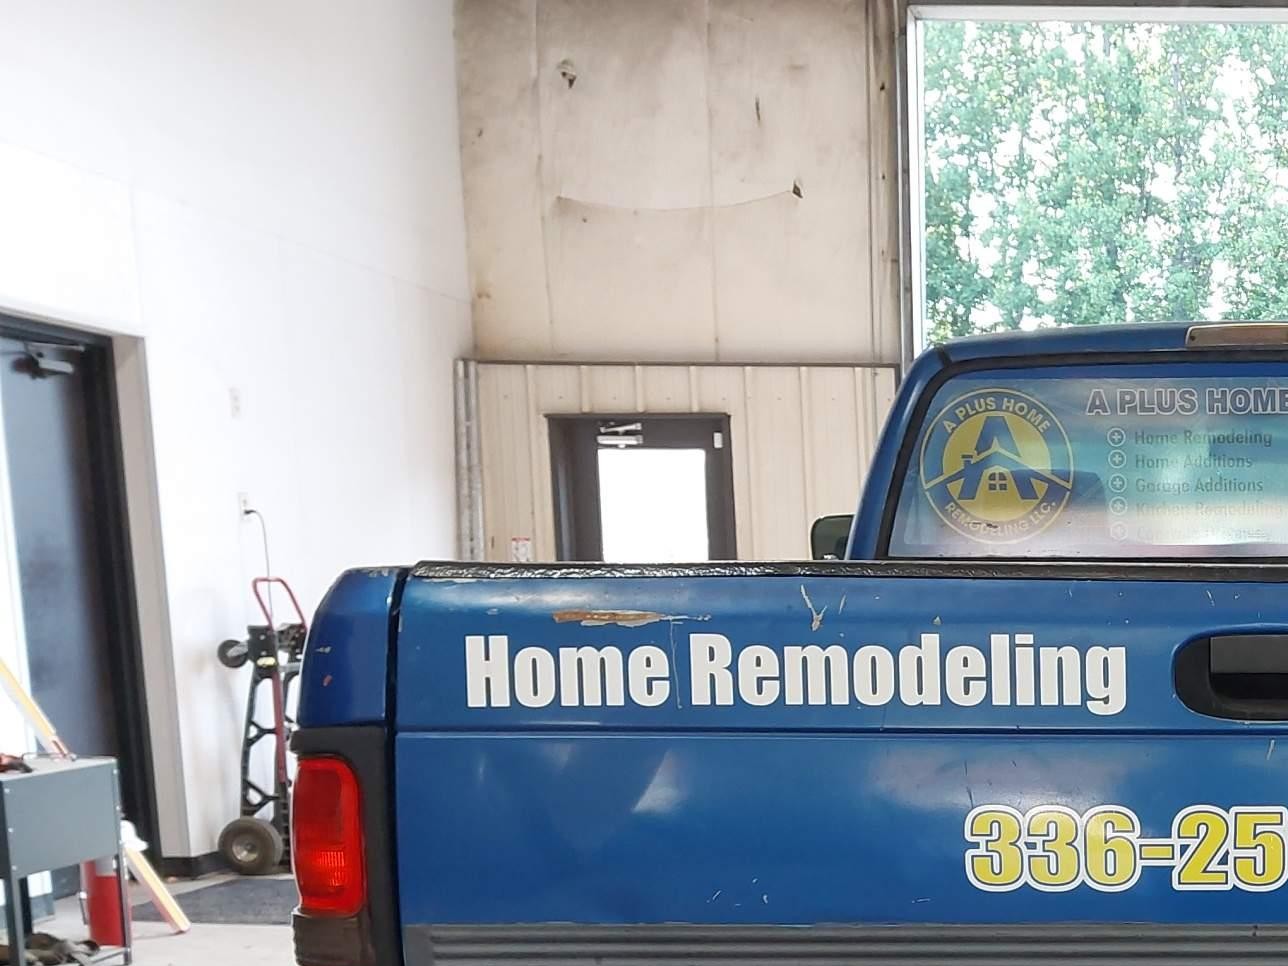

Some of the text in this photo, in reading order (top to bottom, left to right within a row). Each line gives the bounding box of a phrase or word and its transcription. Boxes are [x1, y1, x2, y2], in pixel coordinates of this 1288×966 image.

[943, 397, 1050, 433] A PLUS HOME
[1087, 388, 1110, 415] A
[1117, 388, 1199, 415] PLUS
[1135, 430, 1273, 447] Home Remodeling
[1183, 453, 1253, 468] Additions
[1135, 477, 1264, 495] Garage Additions
[944, 502, 1030, 536] REMODELING
[465, 633, 1127, 715] Home Remodeling
